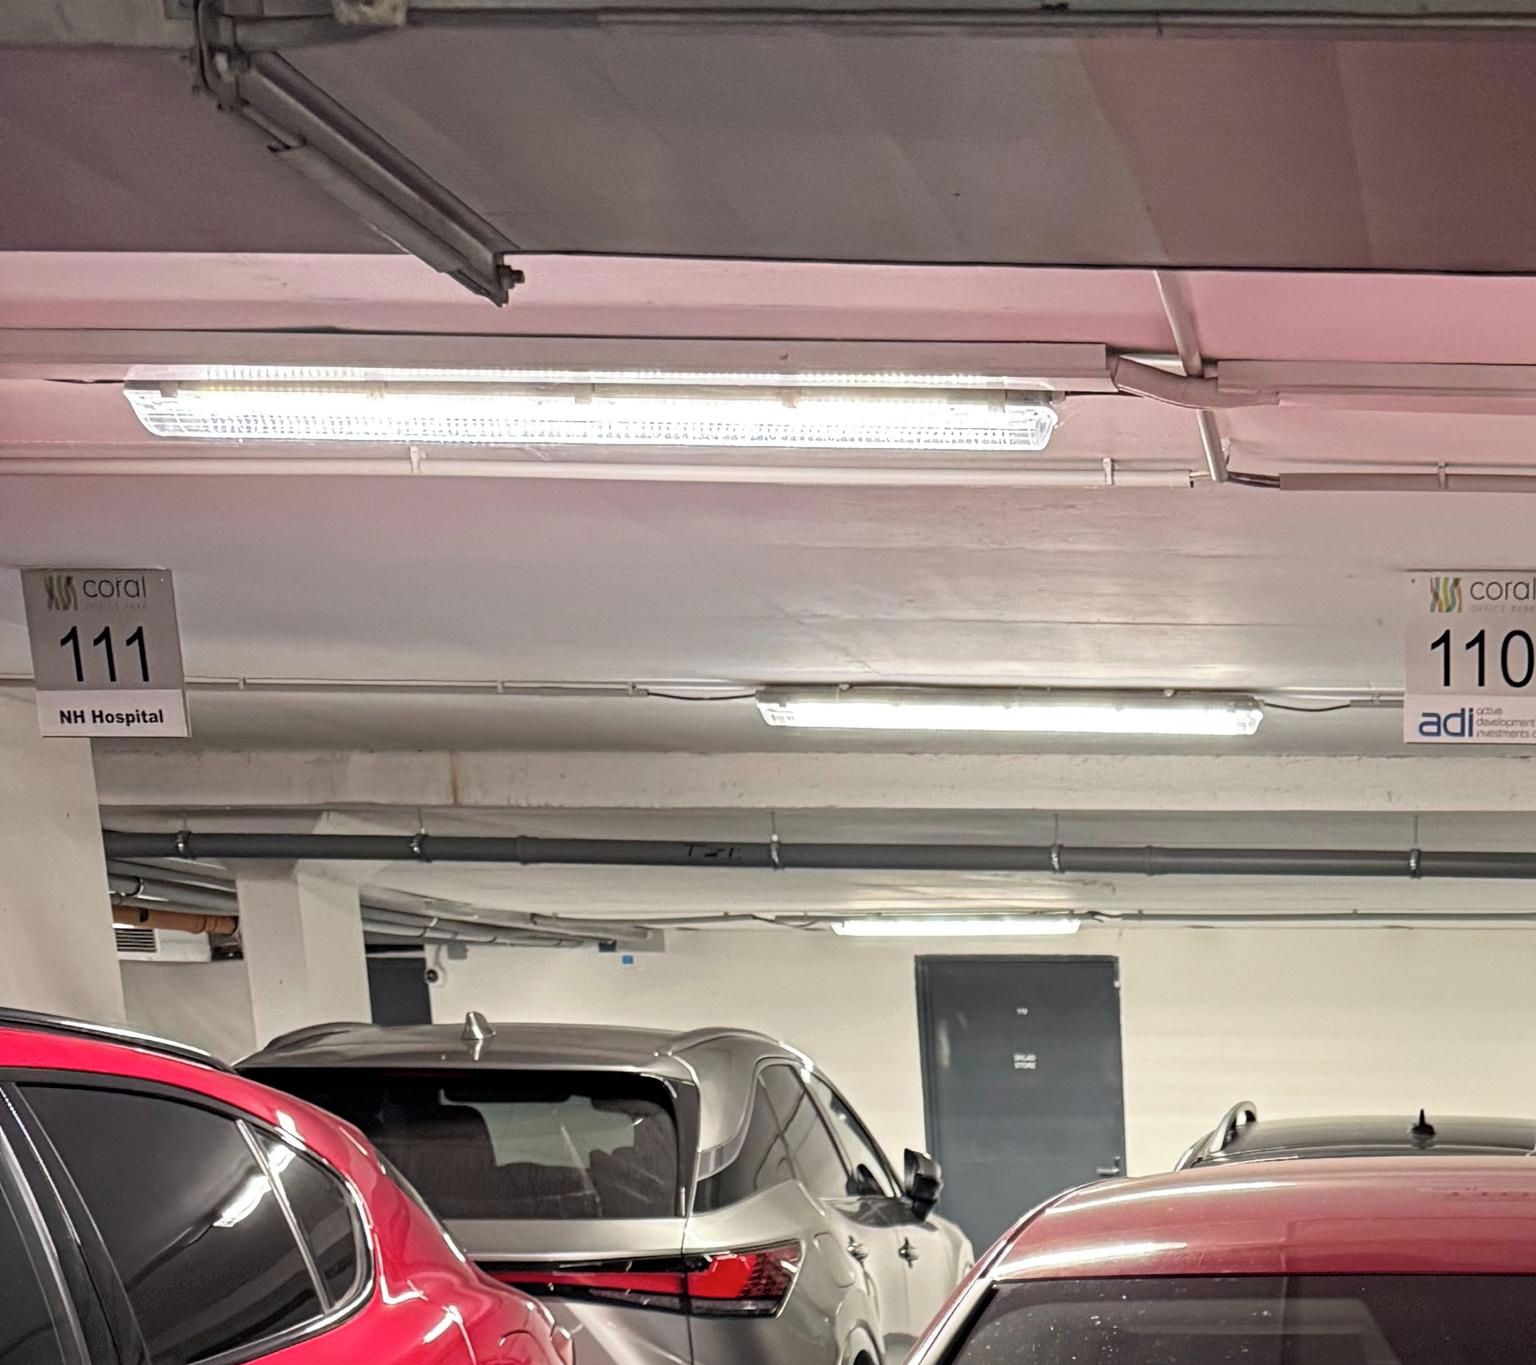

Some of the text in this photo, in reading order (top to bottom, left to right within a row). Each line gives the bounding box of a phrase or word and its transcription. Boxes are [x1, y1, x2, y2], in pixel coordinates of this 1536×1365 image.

[83, 576, 147, 598] coral
[1470, 577, 1536, 600] coral
[60, 625, 150, 683] 111
[1430, 629, 1535, 688] 110
[59, 709, 164, 727] NH Hospital
[1418, 707, 1474, 738] adi
